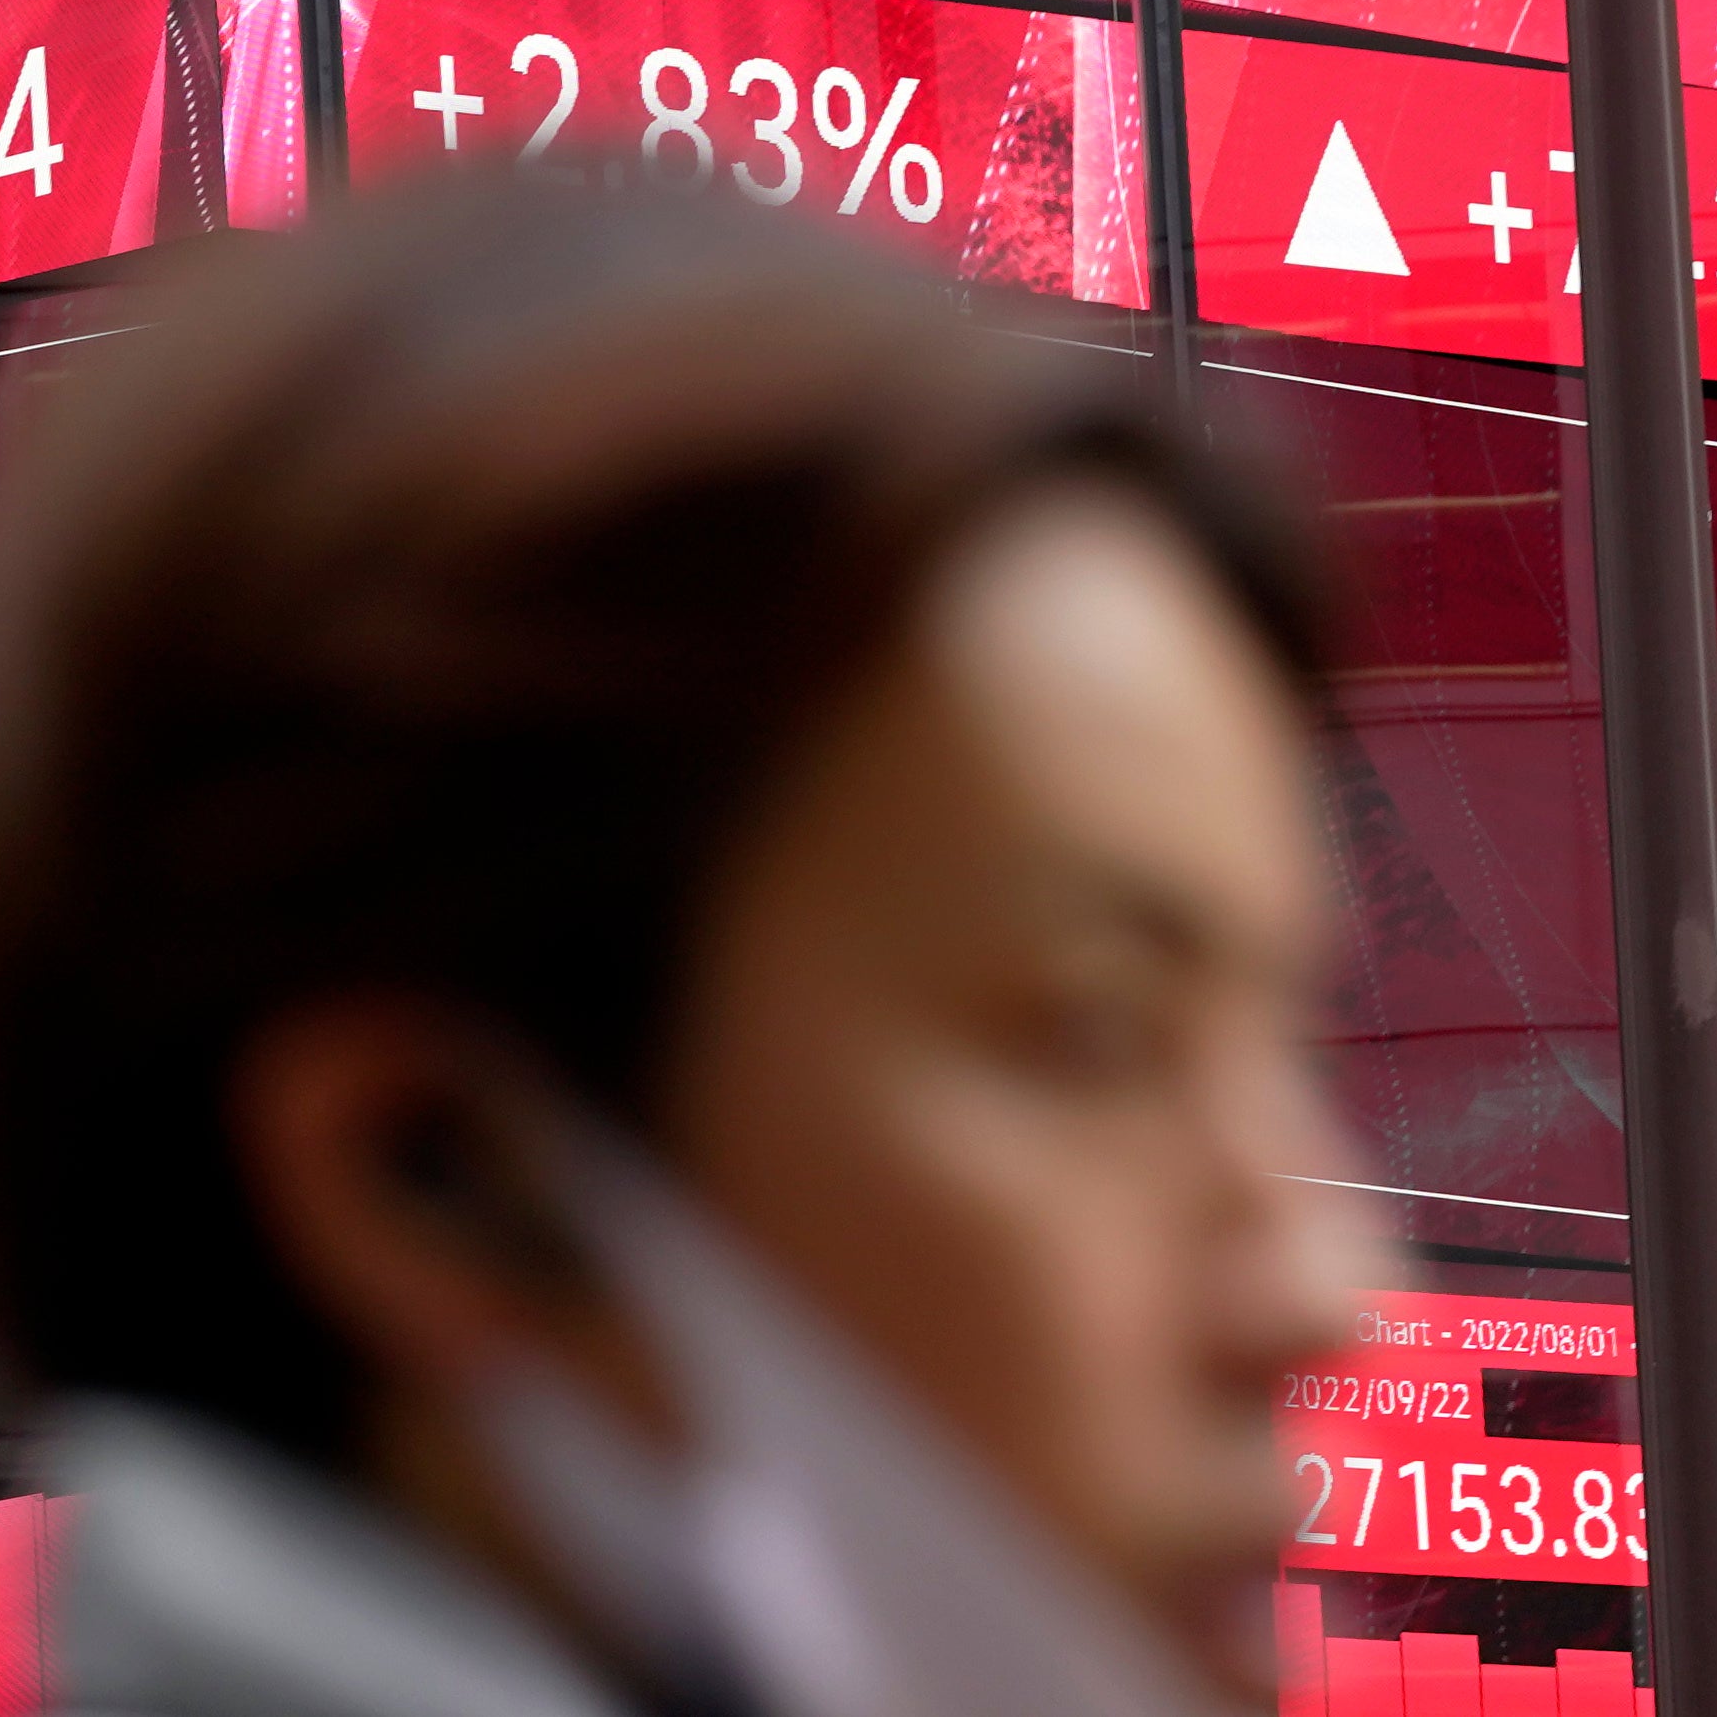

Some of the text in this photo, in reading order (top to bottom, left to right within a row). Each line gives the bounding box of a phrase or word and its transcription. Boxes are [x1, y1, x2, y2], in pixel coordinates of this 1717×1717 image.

[1356, 1311, 1432, 1347] Chart
[1461, 1318, 1618, 1359] 2022/08/01
[1283, 1373, 1472, 1424] 2022/09/22
